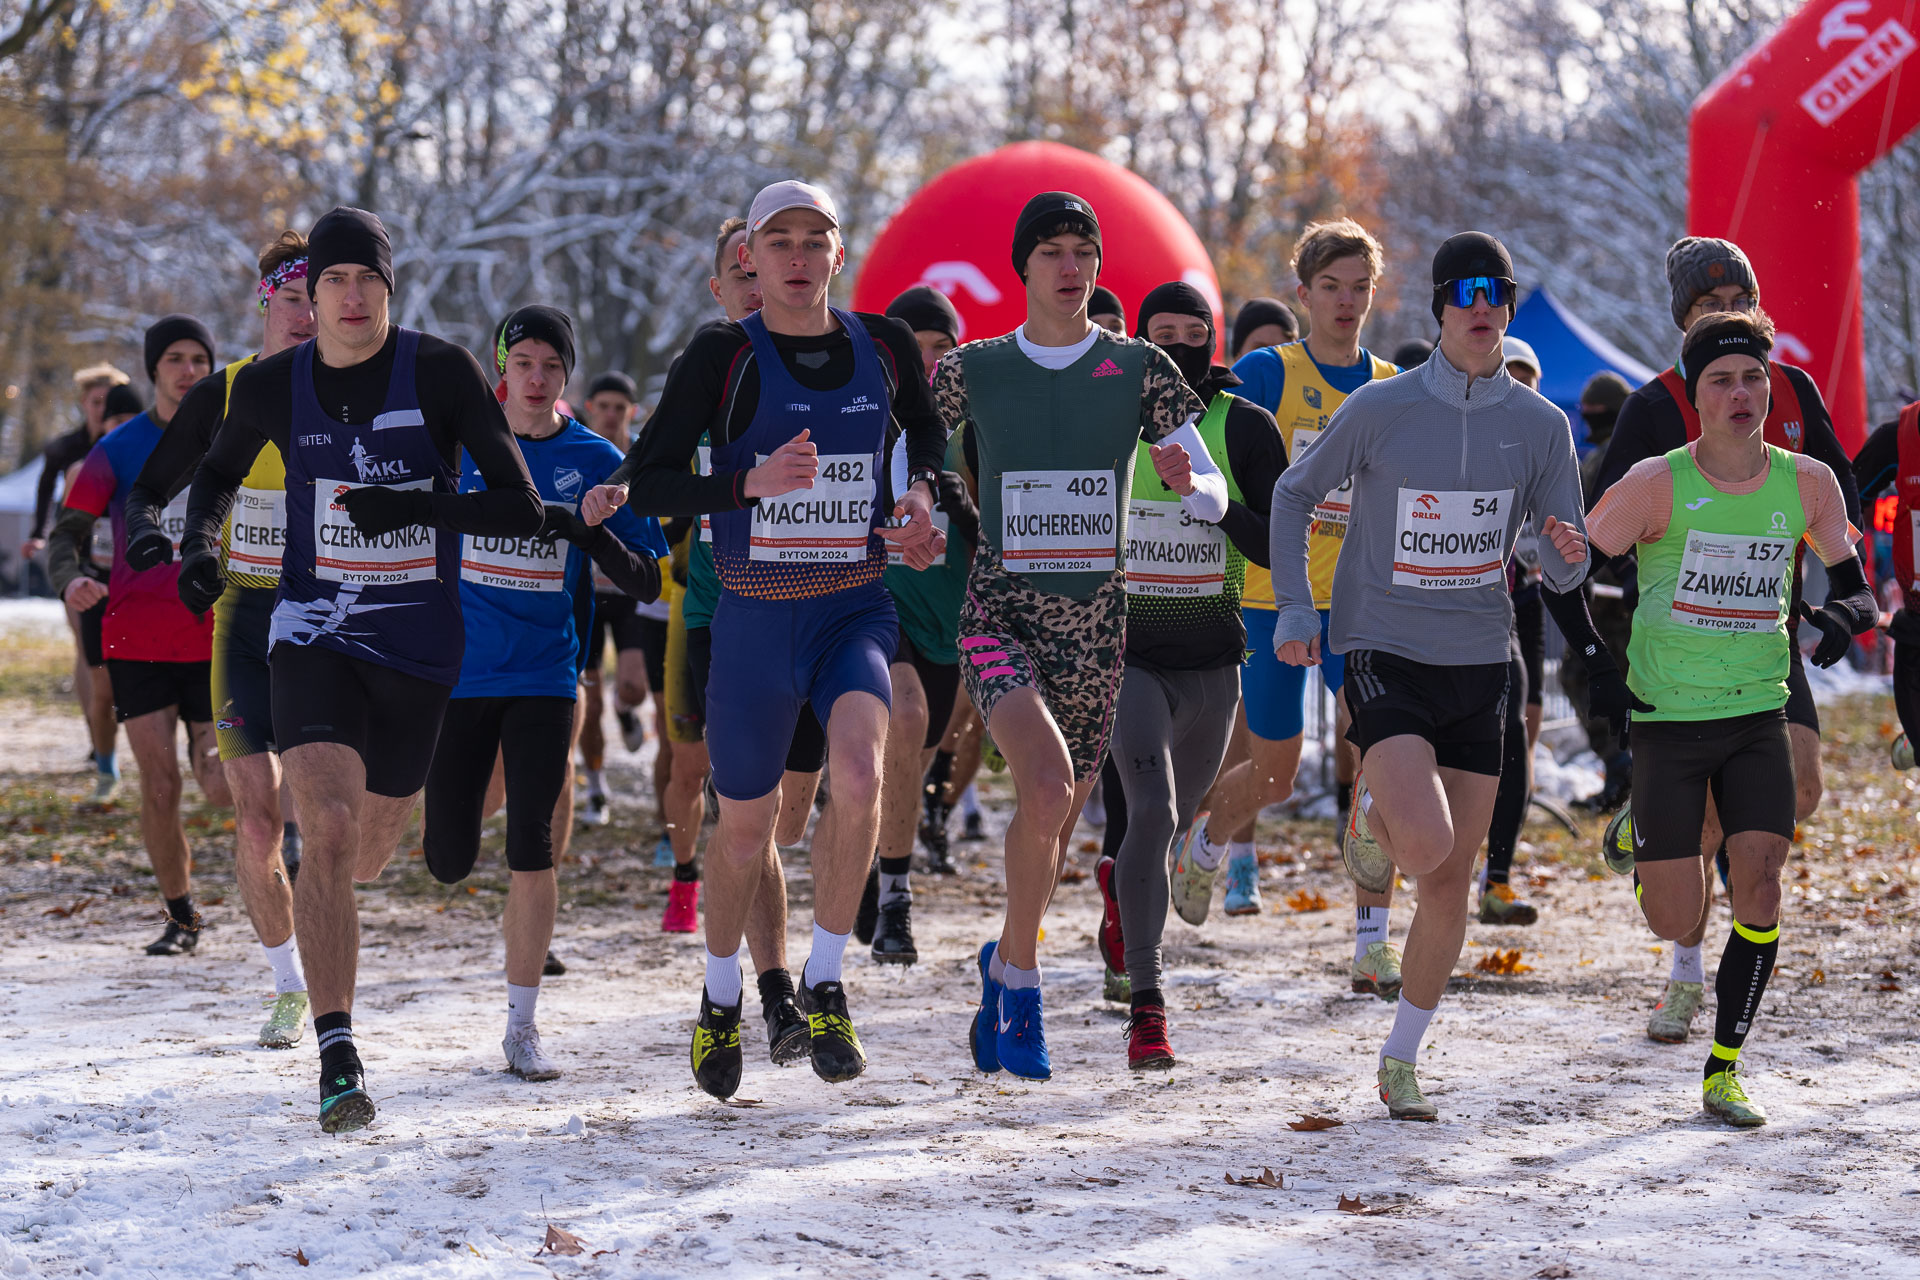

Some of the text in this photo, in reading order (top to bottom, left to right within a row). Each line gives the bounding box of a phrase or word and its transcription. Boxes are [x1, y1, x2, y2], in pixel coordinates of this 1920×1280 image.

[1815, 32, 1902, 112] ORLEN
[1718, 337, 1749, 346] KALENJI
[1092, 368, 1123, 378] adidas
[853, 396, 867, 404] LKS
[841, 403, 879, 414] PSZCZYNA
[362, 460, 411, 478] MKL
[822, 461, 864, 482] 482
[1066, 477, 1108, 496] 402
[244, 495, 259, 505] 770
[756, 500, 868, 524] MACHULEC
[1472, 498, 1498, 517] 54
[1412, 511, 1441, 520] ORLEN
[1007, 513, 1112, 537] KUCHERENKO
[1400, 529, 1502, 554] CICHOWSKI
[780, 551, 848, 559] BYTOM 2024
[1747, 543, 1785, 561] 157
[1068, 561, 1091, 569] 2024
[343, 573, 408, 582] BYTOM 2024
[483, 576, 516, 586] BYTOM
[1420, 577, 1481, 587] BYTOM 2024
[1139, 585, 1173, 593] BYTOM
[1681, 570, 1780, 598] ZAWIŚLAK
[1697, 618, 1732, 628] BYTOM
[1743, 954, 1763, 1019] COMPRESSPORT
